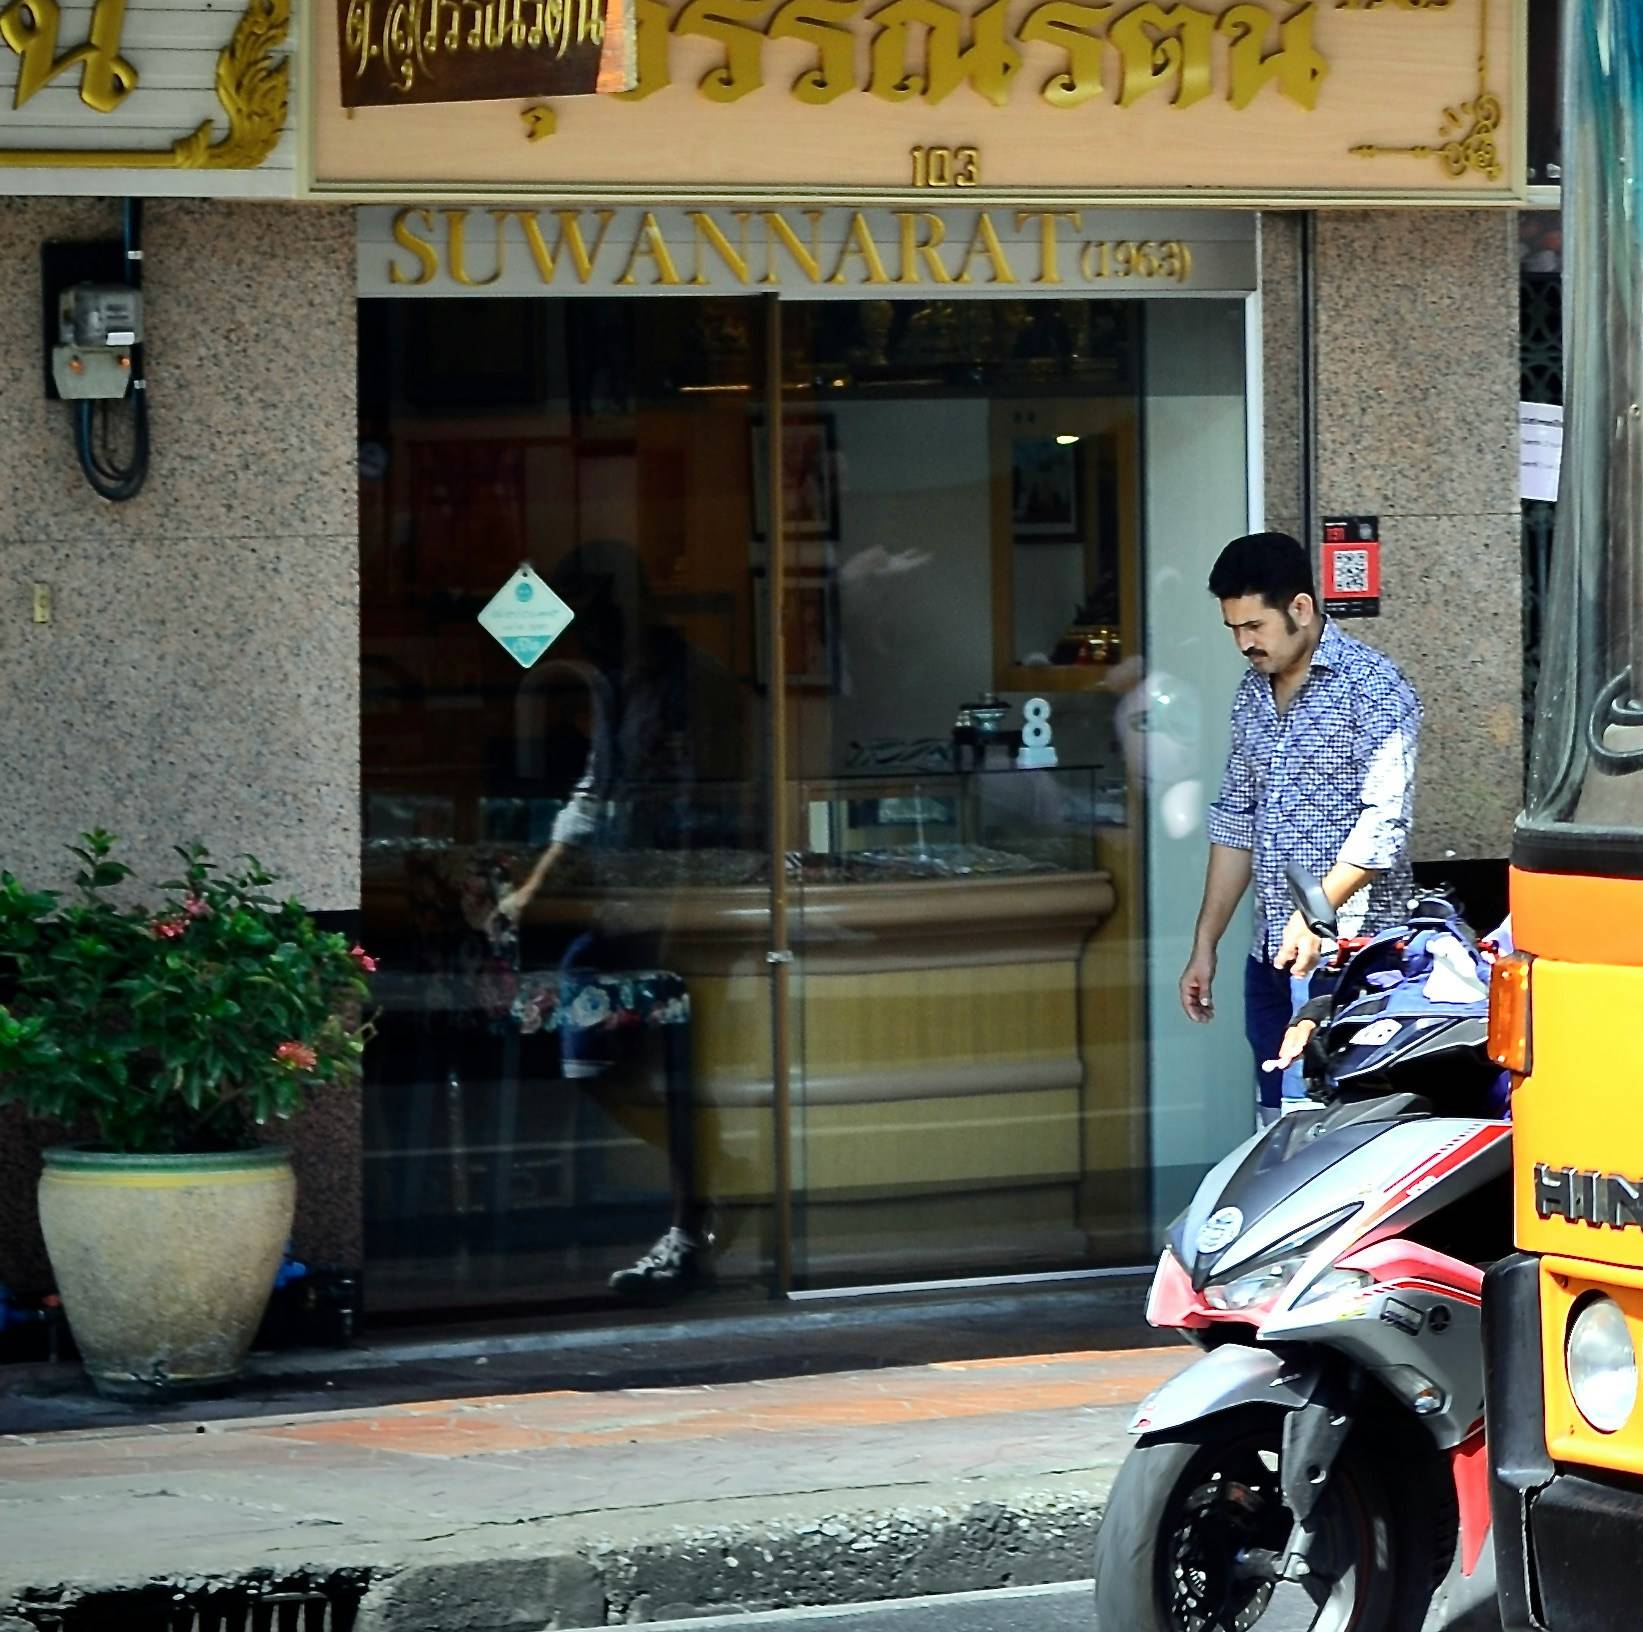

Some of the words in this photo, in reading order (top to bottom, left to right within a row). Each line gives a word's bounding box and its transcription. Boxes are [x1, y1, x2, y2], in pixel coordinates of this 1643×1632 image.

[911, 144, 979, 188] 103
[388, 208, 1081, 287] SUWANNARAT
[1080, 238, 1193, 284] (1963)
